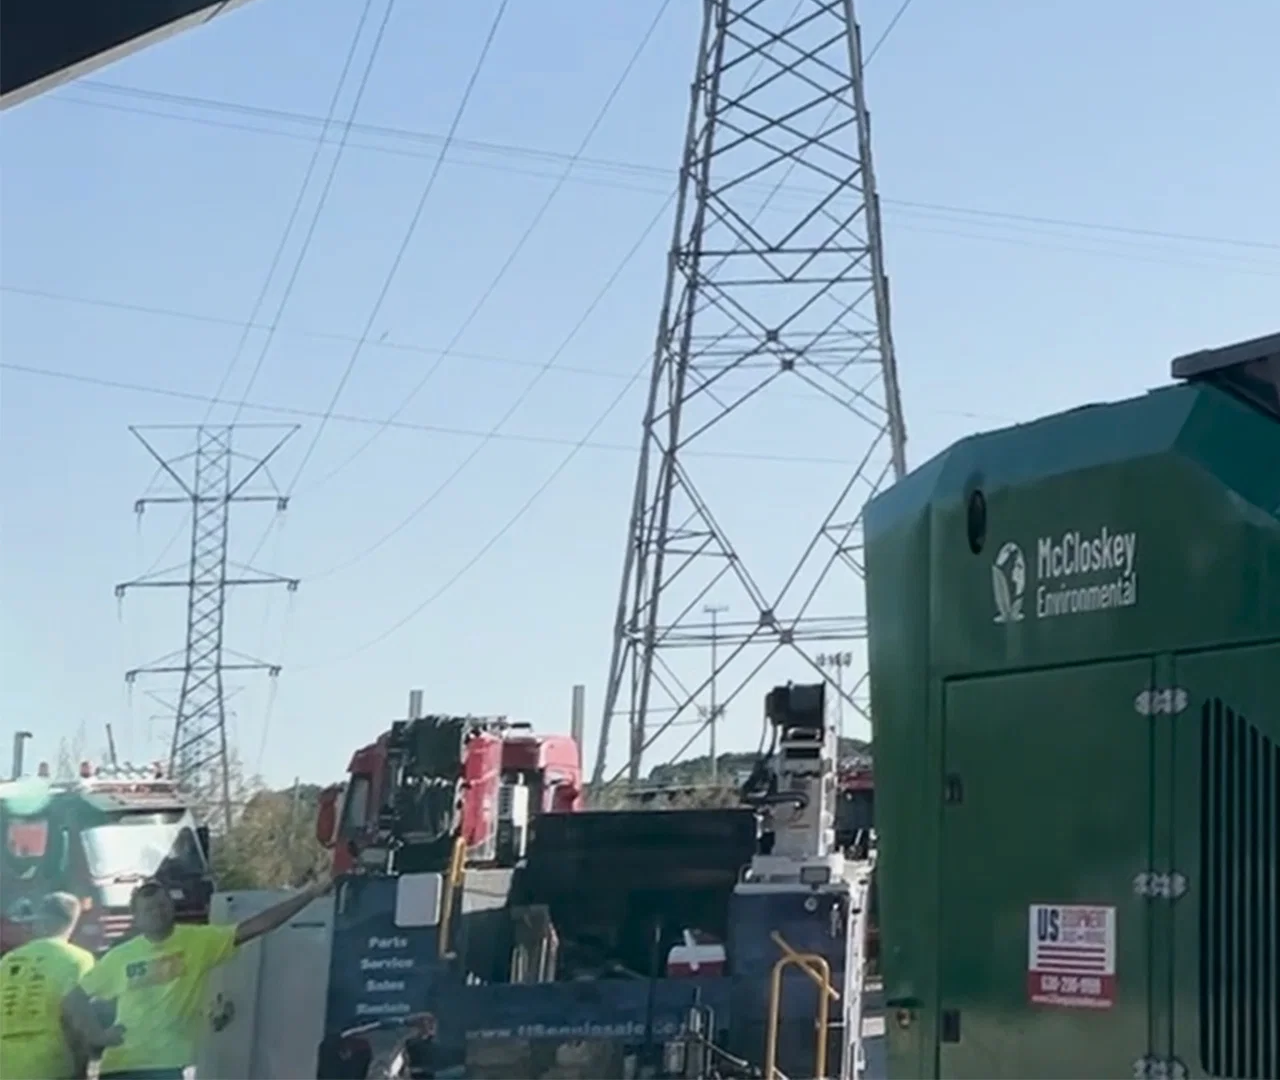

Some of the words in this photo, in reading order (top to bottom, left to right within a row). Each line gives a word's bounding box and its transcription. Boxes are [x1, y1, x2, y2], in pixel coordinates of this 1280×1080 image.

[1037, 526, 1136, 578] McCloskey
[1037, 572, 1136, 618] Environmental
[1037, 907, 1060, 942] US
[368, 936, 408, 949] Parts
[361, 957, 414, 970] Service
